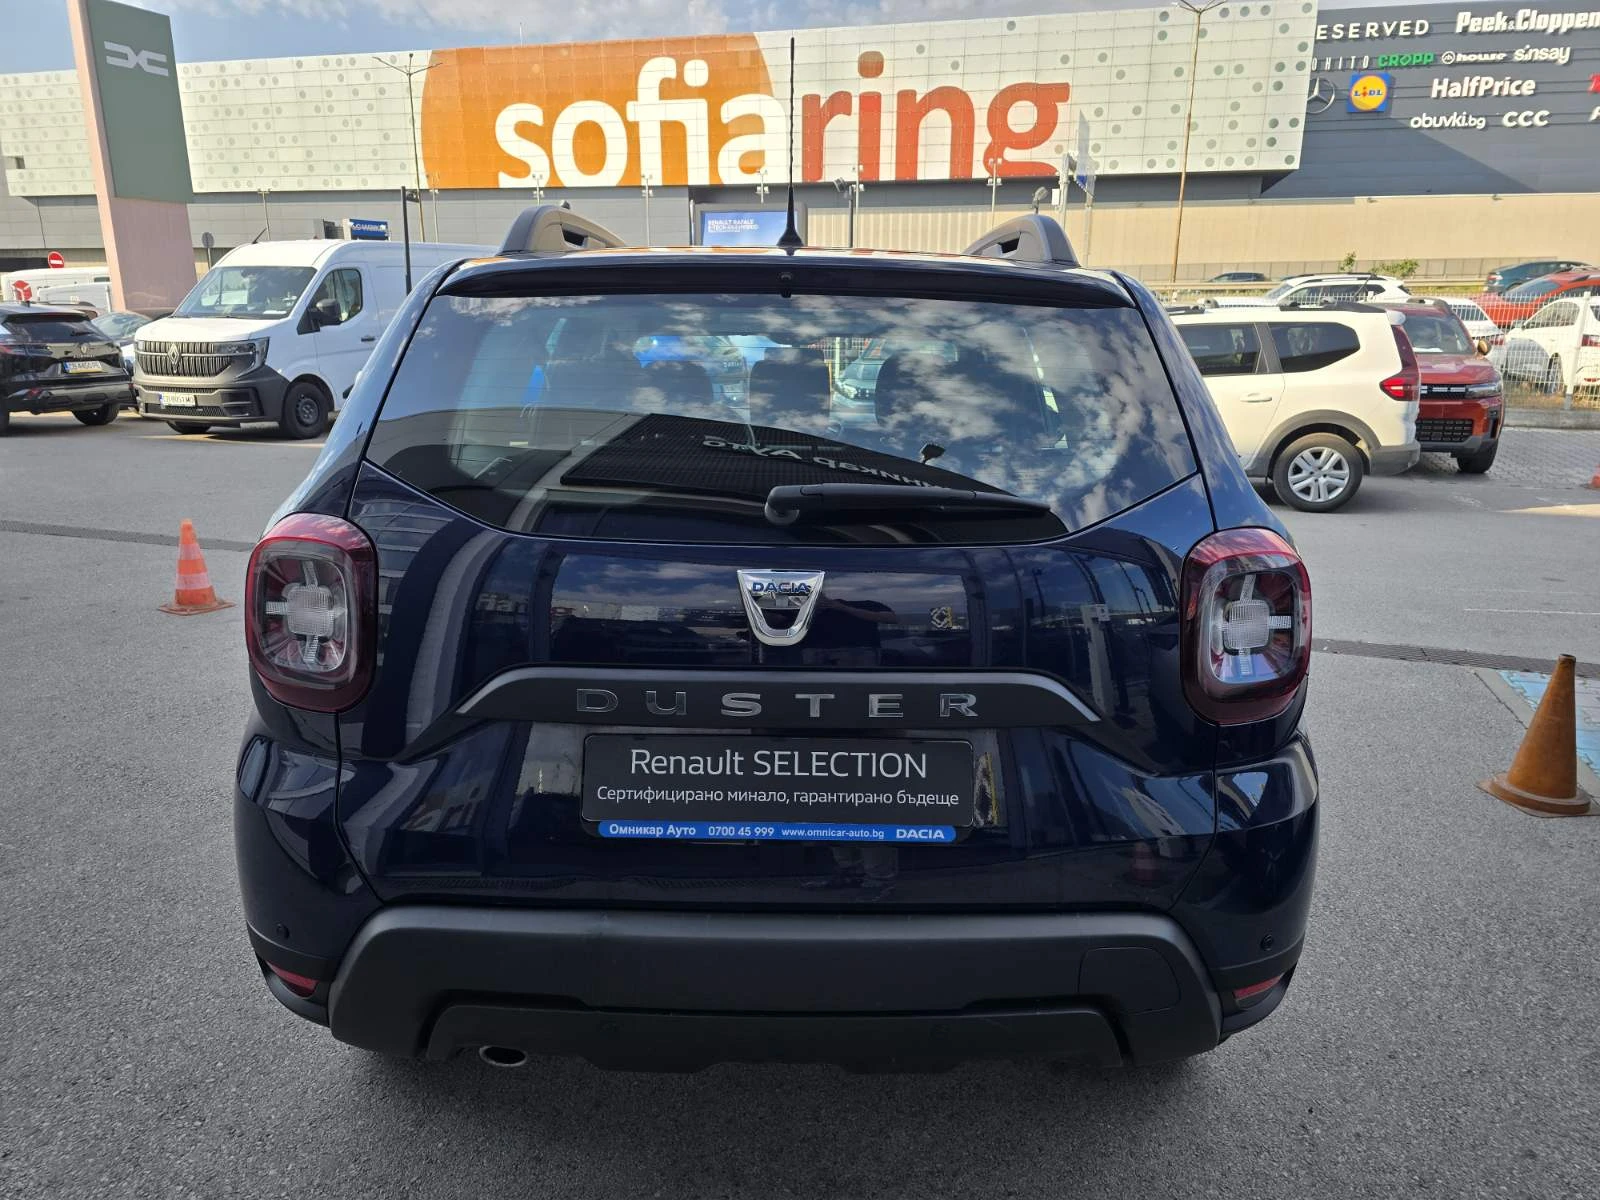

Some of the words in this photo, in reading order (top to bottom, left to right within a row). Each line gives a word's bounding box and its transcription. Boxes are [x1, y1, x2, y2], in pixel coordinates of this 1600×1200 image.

[1378, 52, 1435, 67] CROPP
[1431, 76, 1536, 98] HalfPrice
[1410, 112, 1486, 130] obuvki.bg
[752, 582, 810, 594] DACIA
[576, 688, 978, 718] DUSTER
[631, 749, 744, 776] Renault
[753, 750, 927, 778] SELECTION
[597, 786, 723, 804] Сертифицирано
[727, 791, 790, 804] минало,
[793, 792, 893, 806] гарантирано
[896, 789, 960, 807] бъдеще
[609, 823, 663, 837] Омникар
[666, 824, 696, 838] Ауто
[708, 826, 735, 836] 0700
[737, 826, 751, 836] 45
[754, 826, 774, 837] 999
[781, 826, 885, 840] www.omnicar-auto.bg
[895, 828, 945, 839] DACIA
